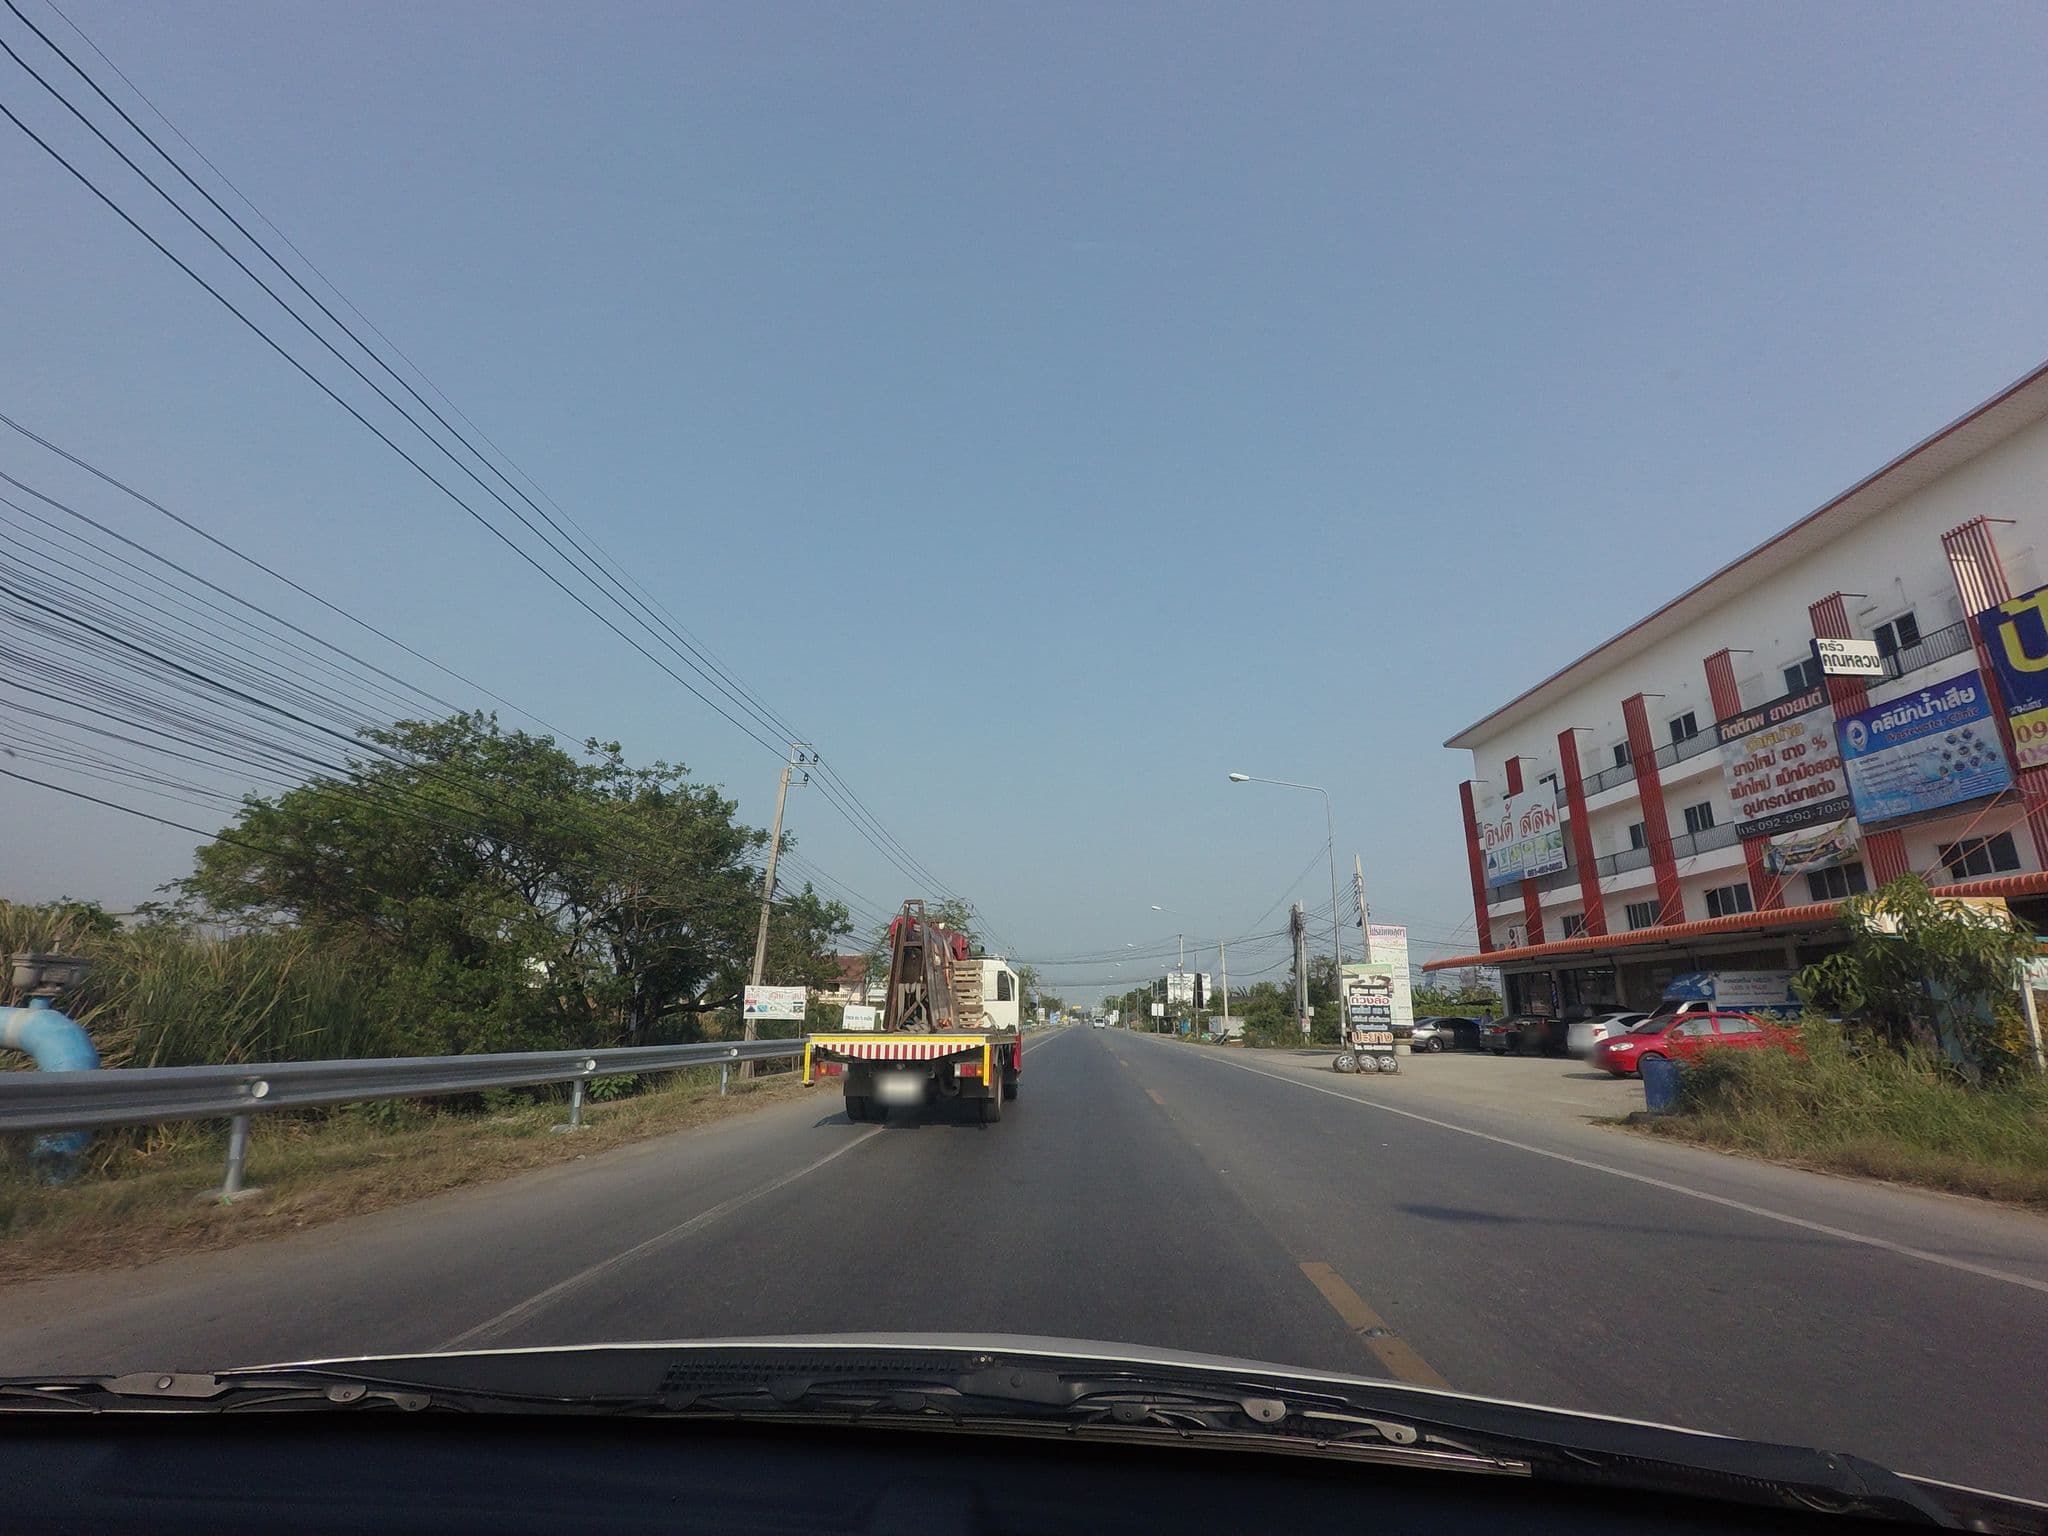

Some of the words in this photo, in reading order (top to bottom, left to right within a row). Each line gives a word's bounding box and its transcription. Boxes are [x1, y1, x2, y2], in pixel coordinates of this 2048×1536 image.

[1819, 640, 1845, 652] ครัว
[1822, 654, 1881, 673] คุณหลวง
[1769, 687, 1824, 721] ยางยนต์
[1871, 686, 1976, 734] คลินิกน้ำเสีย
[1782, 743, 1806, 761] ยาง
[1352, 1030, 1393, 1044] ปะยาง
